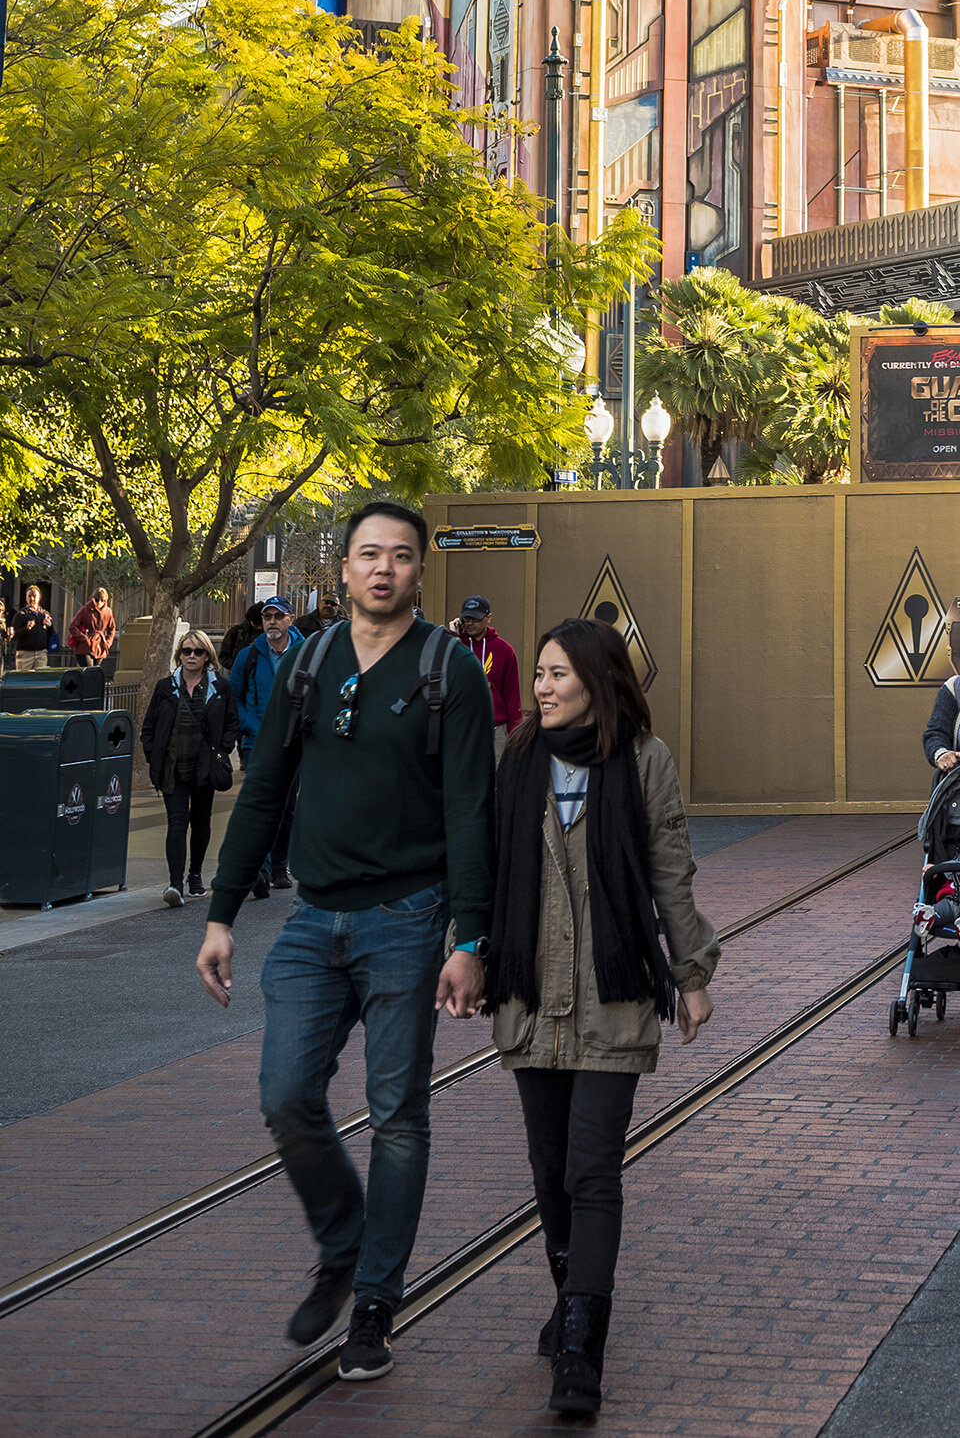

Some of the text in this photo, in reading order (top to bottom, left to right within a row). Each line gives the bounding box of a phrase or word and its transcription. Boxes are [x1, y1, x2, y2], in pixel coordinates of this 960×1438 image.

[881, 361, 931, 370] CURRENTLY
[934, 360, 948, 369] ON
[930, 399, 948, 411] OF
[923, 410, 948, 422] THE
[932, 445, 957, 453] OPEN
